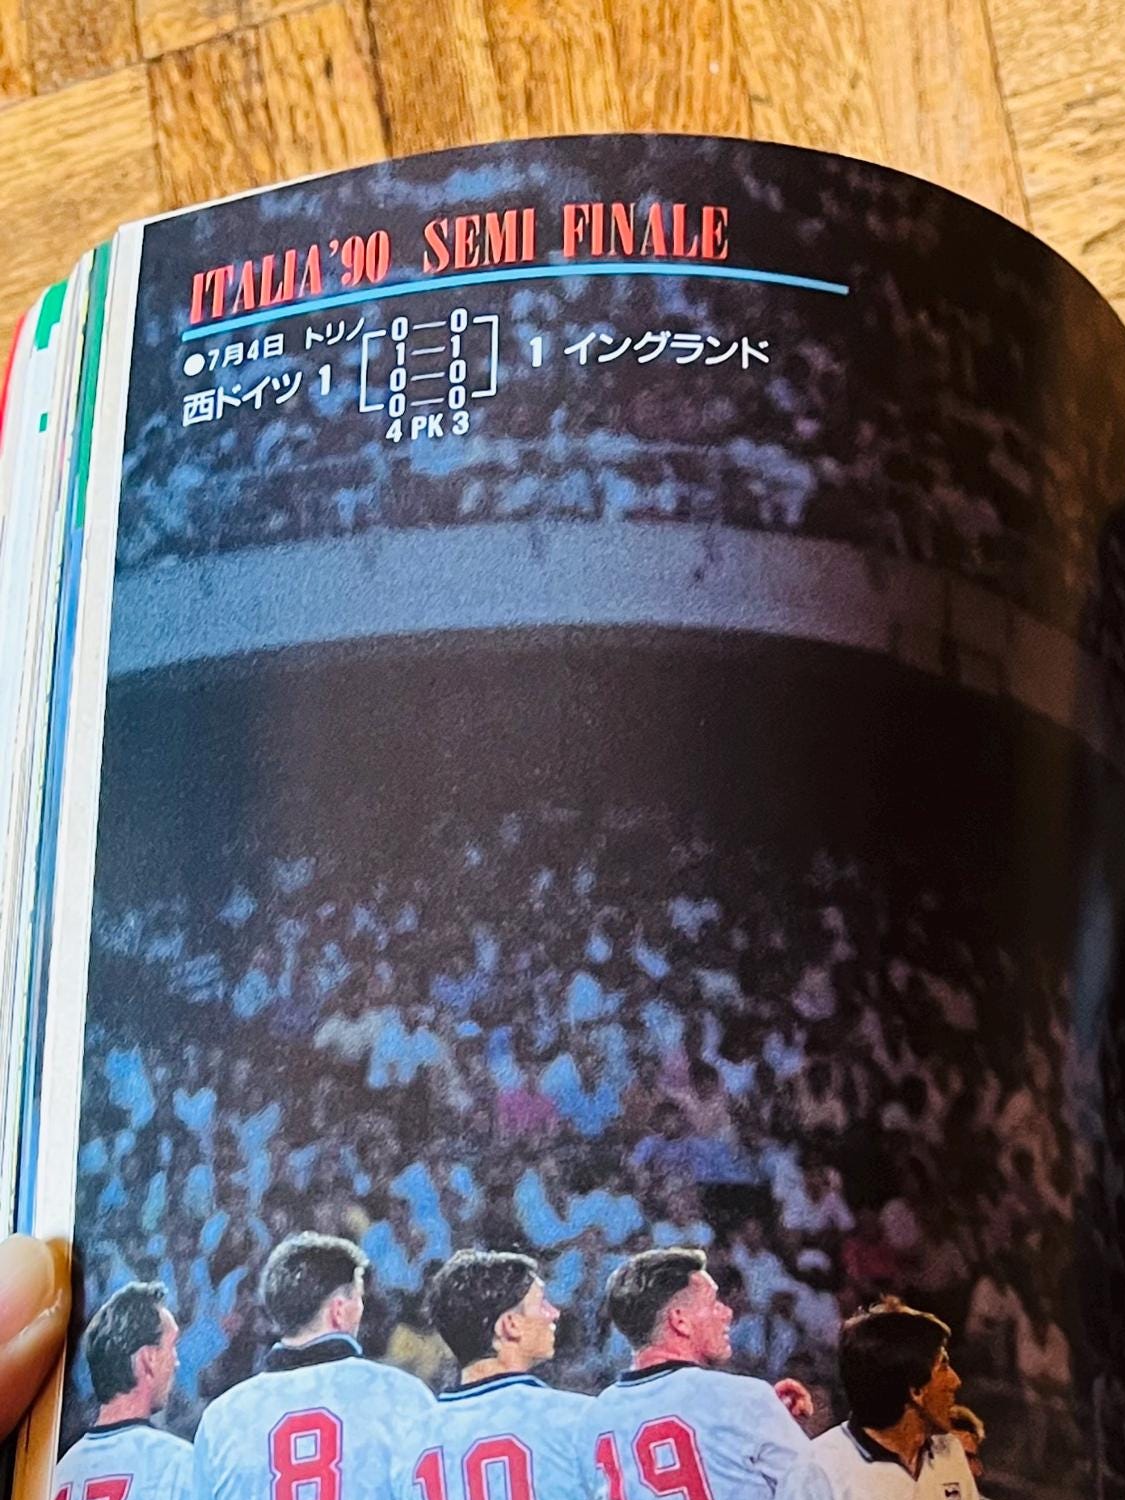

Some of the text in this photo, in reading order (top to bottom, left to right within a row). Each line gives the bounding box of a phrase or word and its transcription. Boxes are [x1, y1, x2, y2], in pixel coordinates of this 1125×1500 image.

[189, 202, 729, 324] ITALIA'90 SEMI FINALE
[305, 317, 365, 350] トリノ
[529, 331, 769, 369] 1 イングランド
[182, 363, 331, 428] 西ドイツ 1
